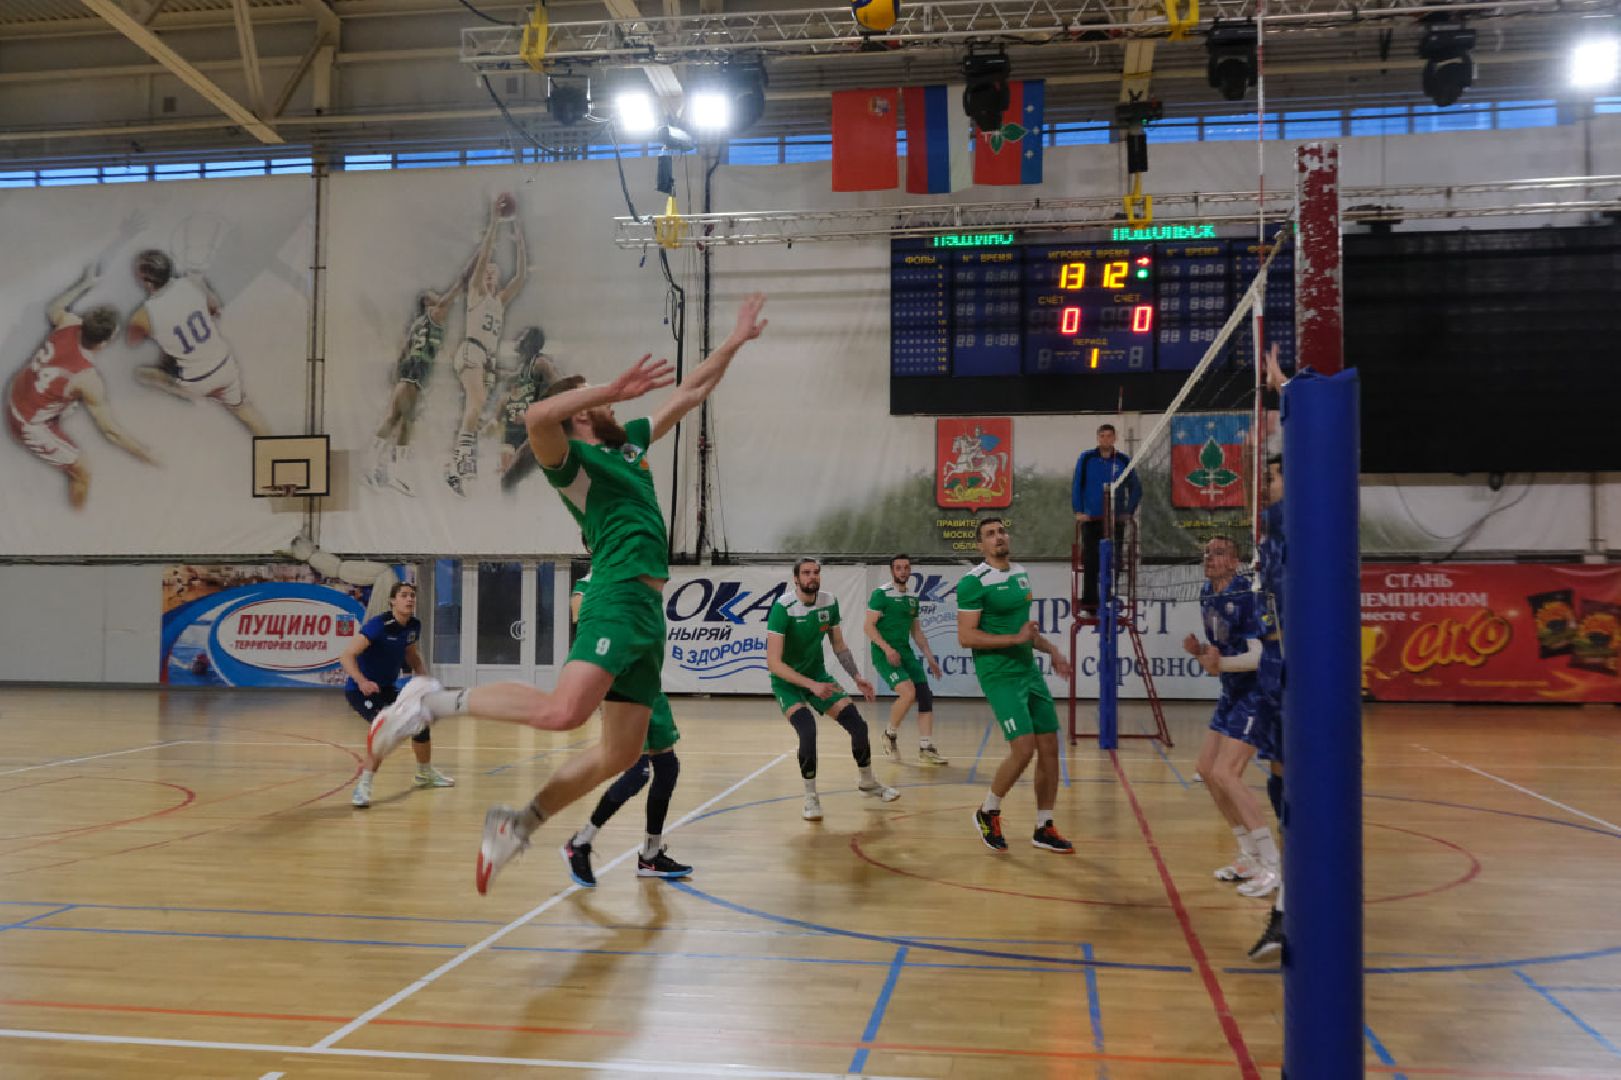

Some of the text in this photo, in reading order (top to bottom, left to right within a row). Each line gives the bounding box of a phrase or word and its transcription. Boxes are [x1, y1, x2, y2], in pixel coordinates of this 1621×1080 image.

[1060, 262, 1128, 289] 13 12
[1061, 307, 1080, 333] 0
[1132, 305, 1152, 332] 0
[173, 310, 211, 354] 10
[1090, 348, 1099, 368] 1
[1385, 572, 1453, 588] СТАНЬ
[237, 614, 332, 640] ПУЩИНО
[1360, 611, 1406, 621] месте
[234, 640, 328, 650] ТЕРРИТОРИЯ СПОРТА
[668, 625, 732, 641] НЫРЯЙ
[672, 637, 768, 665] В ЗДОРОВЬ
